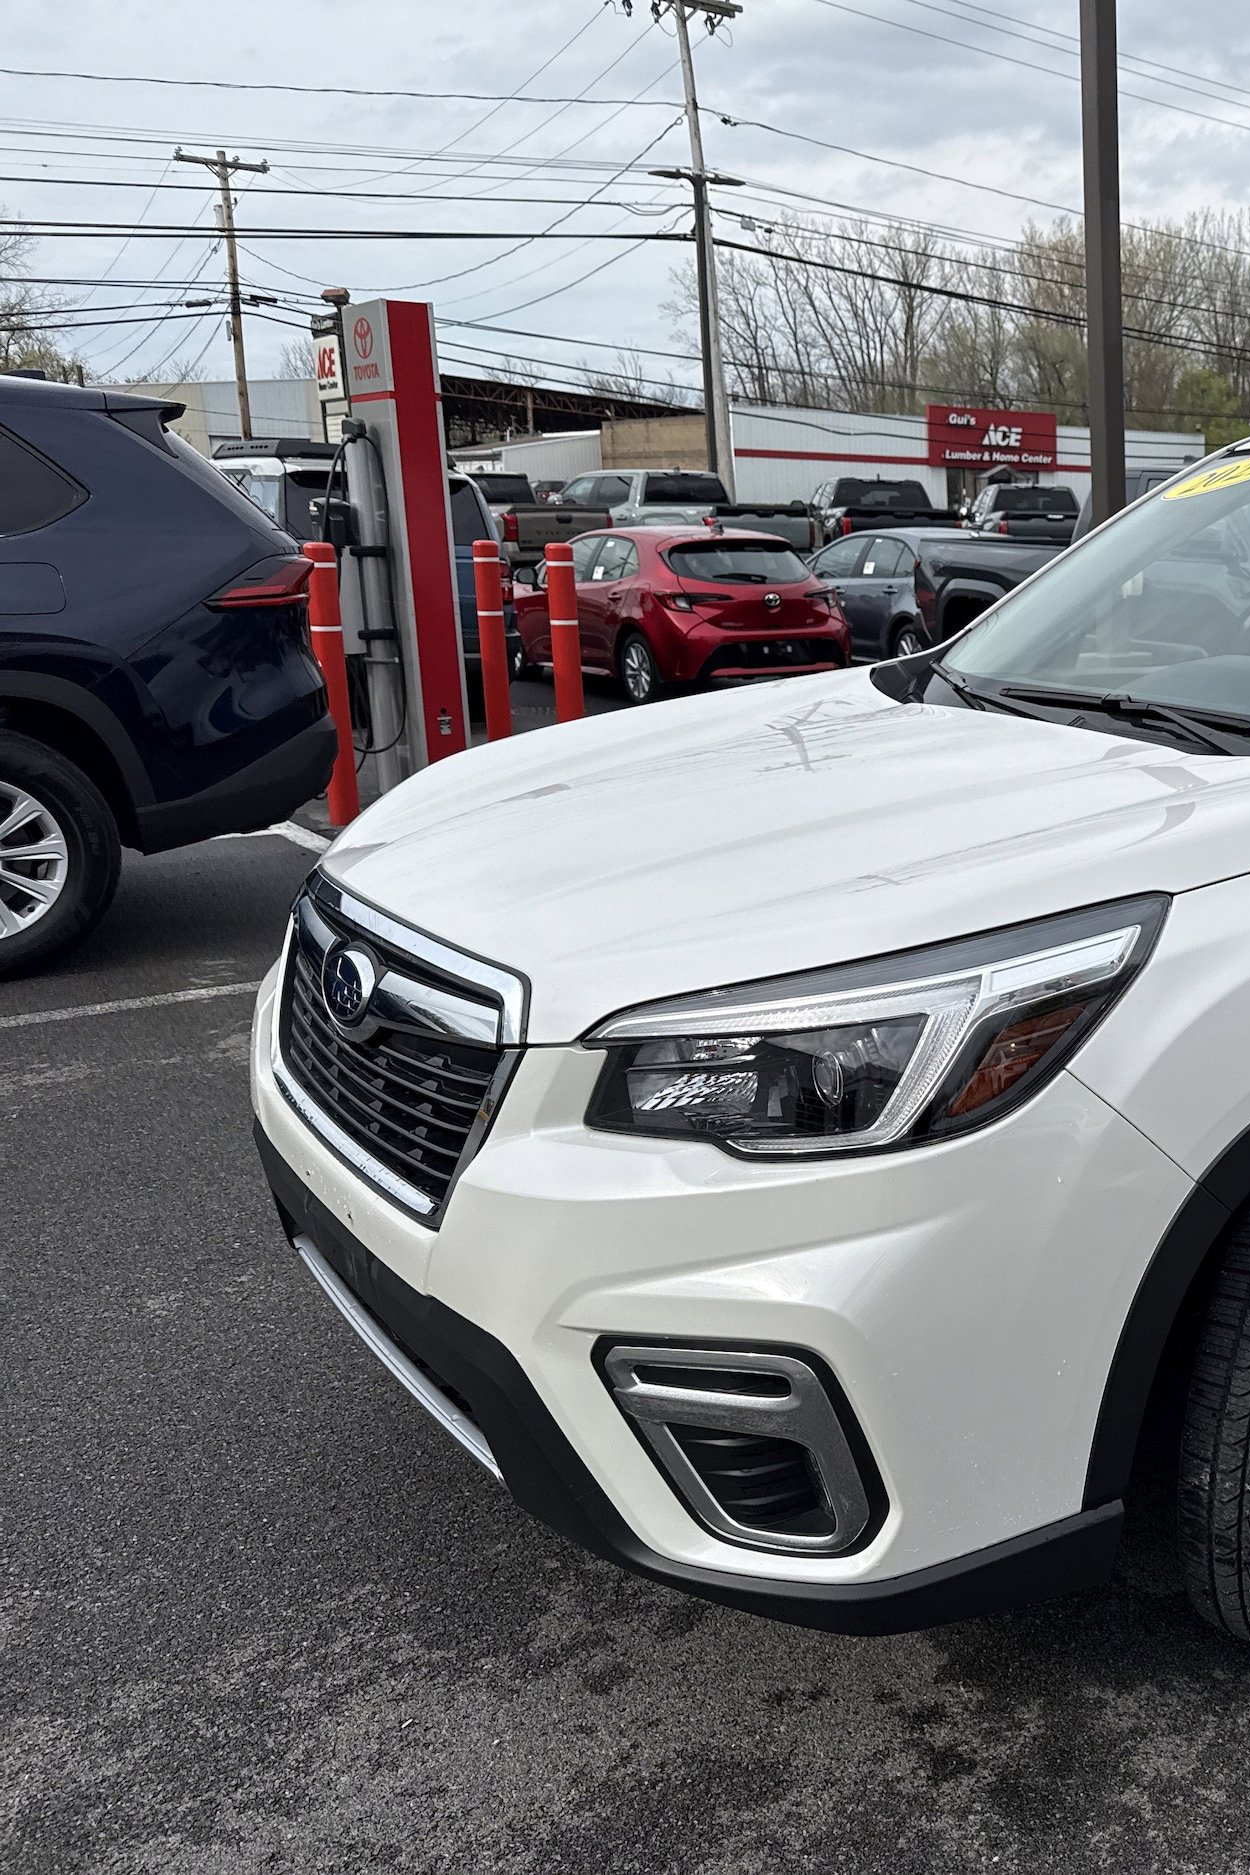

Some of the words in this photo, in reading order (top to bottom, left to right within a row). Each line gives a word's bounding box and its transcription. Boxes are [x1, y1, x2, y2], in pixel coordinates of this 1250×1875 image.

[318, 347, 335, 380] ACE
[353, 364, 380, 381] TOYOTA
[948, 413, 976, 425] Gui's
[982, 422, 1023, 447] ACE
[945, 449, 982, 460] Lumber
[982, 451, 990, 461] &
[992, 451, 1019, 462] Home
[1021, 453, 1053, 464] Center
